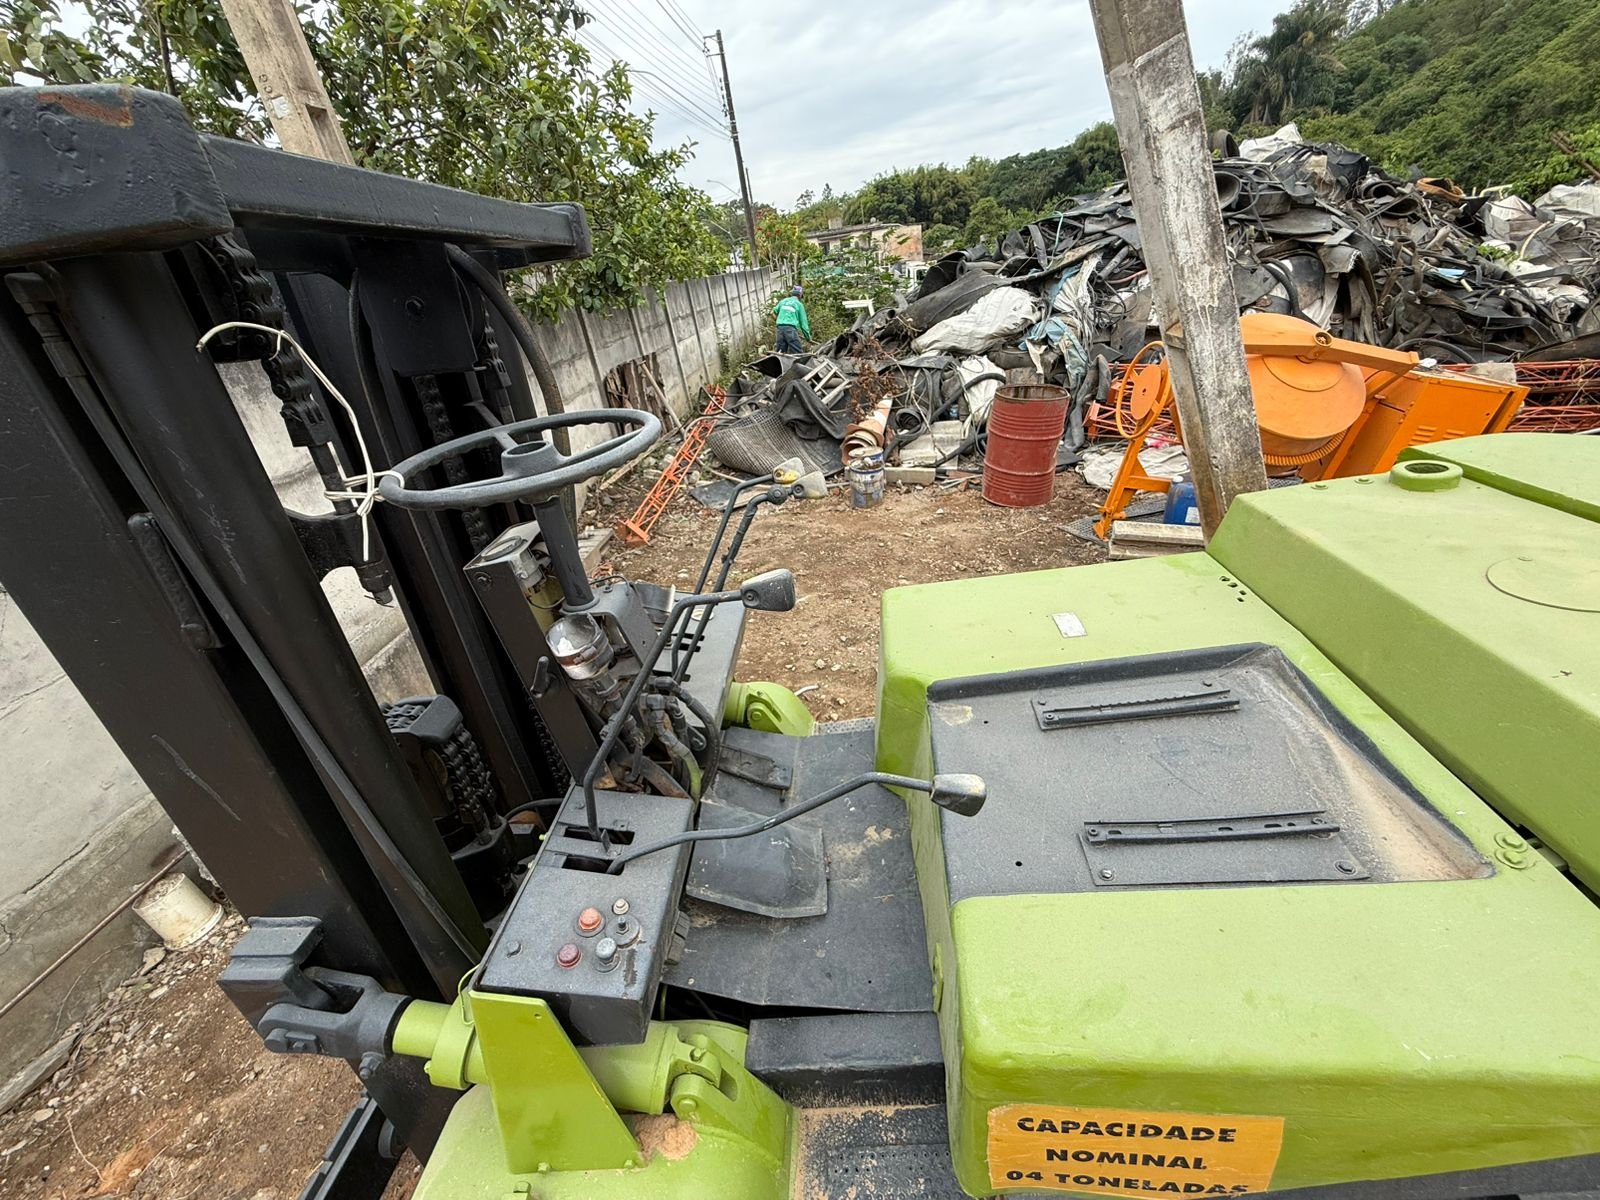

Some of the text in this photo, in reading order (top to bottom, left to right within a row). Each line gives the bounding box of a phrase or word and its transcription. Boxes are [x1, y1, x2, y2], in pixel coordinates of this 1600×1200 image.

[1017, 1117, 1237, 1142] CAPACIDADE
[1046, 1149, 1207, 1169] NOMINAL
[1006, 1170, 1249, 1194] 04 TONELADAS
